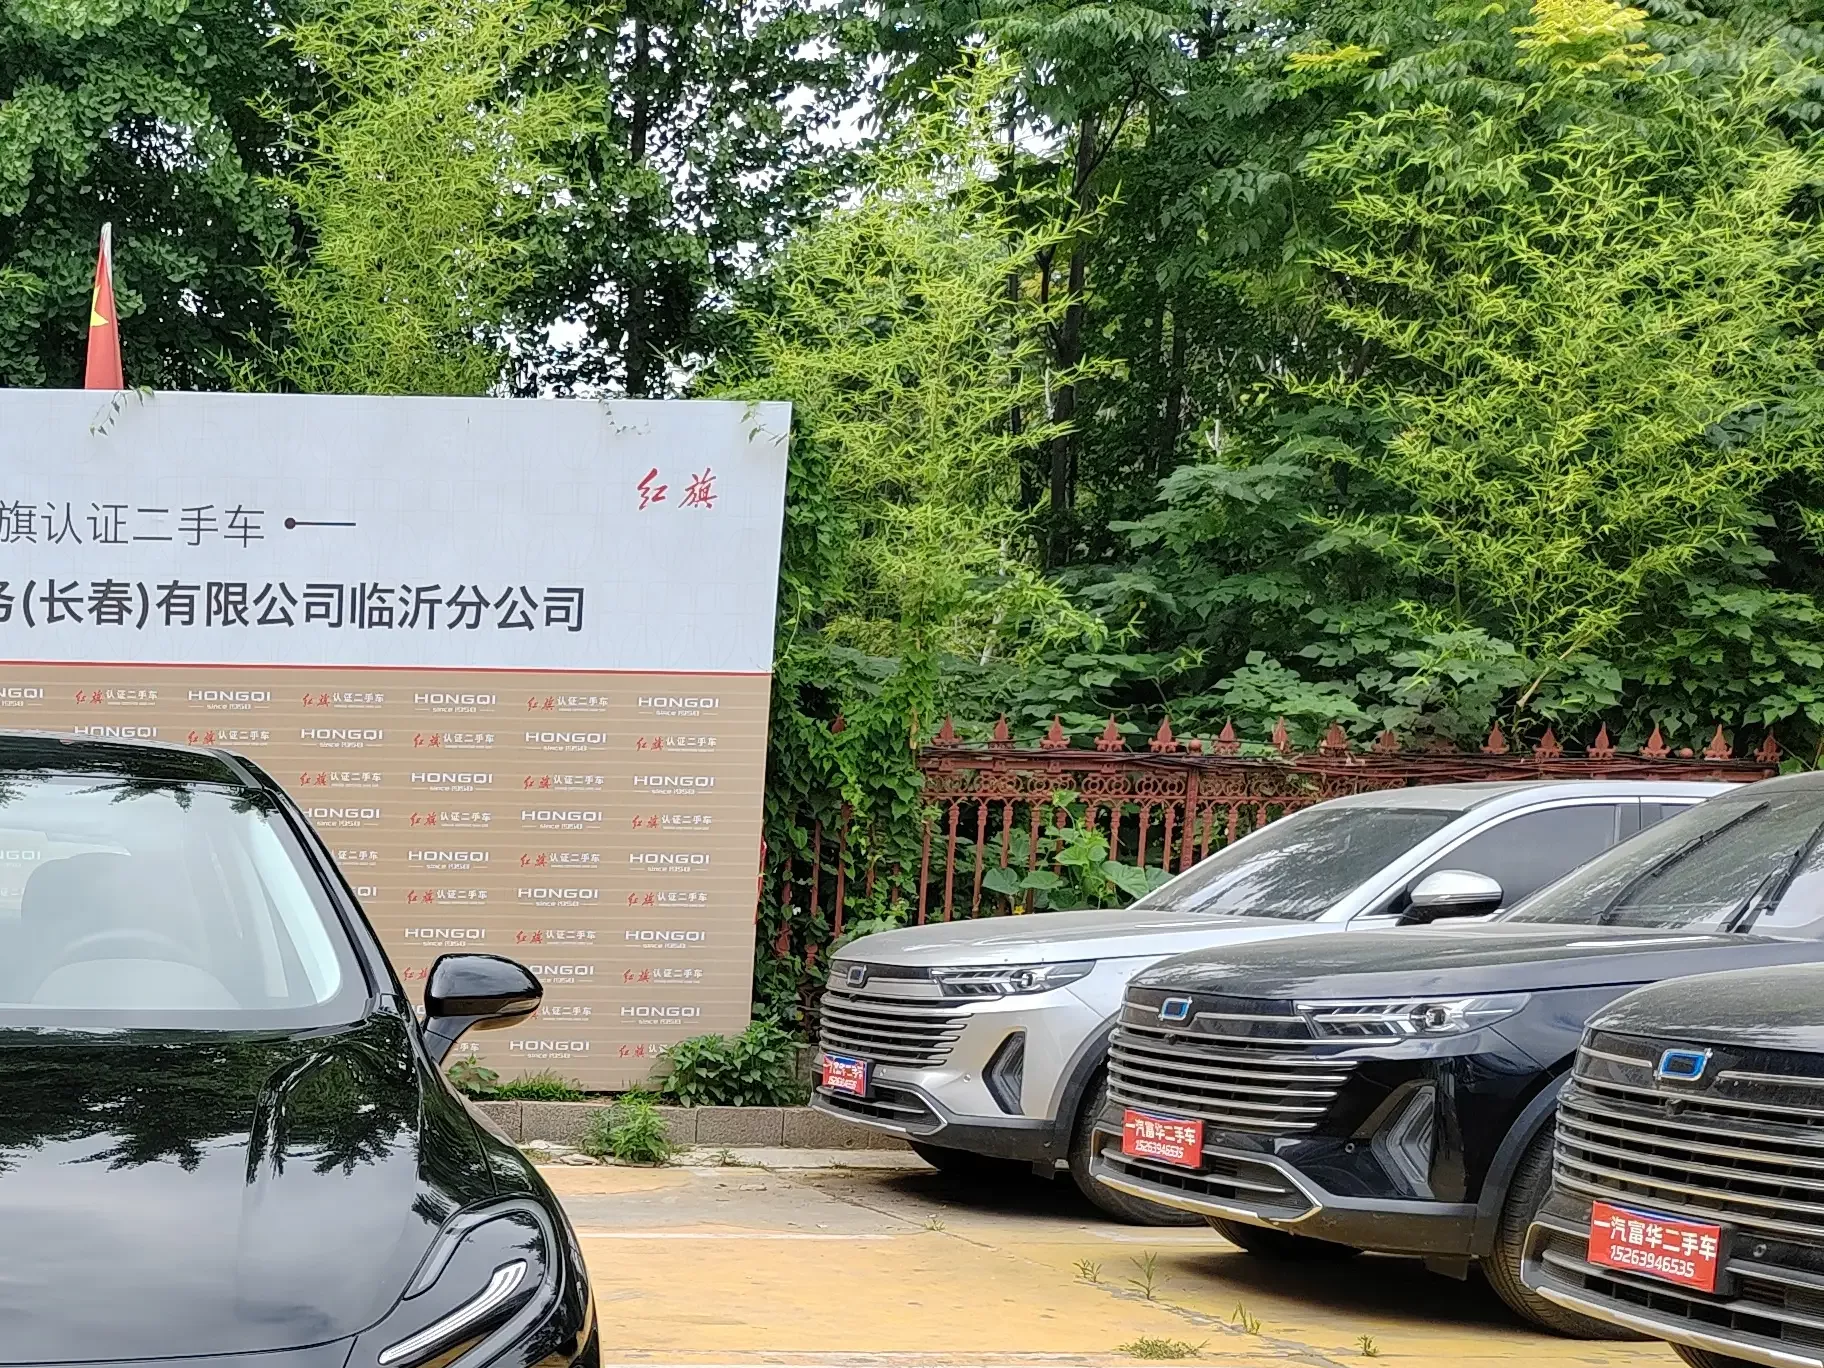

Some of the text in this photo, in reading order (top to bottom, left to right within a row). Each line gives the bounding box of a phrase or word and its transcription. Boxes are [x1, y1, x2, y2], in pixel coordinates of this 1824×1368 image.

[636, 467, 717, 511] 红旗
[106, 690, 157, 699] 认证二手车
[189, 691, 270, 701] HONGQI
[333, 693, 383, 702] 认证二手车
[415, 694, 495, 704] HONGQI
[558, 697, 608, 706] 认证二手车
[639, 697, 718, 708] HONGQI
[74, 726, 156, 737] HONGQI
[219, 731, 269, 740] 认证二手车
[301, 729, 382, 740] HONGQI
[444, 734, 494, 743] 认证二手车
[526, 732, 606, 743] HONGQI
[666, 737, 716, 746] 认证二手车
[331, 772, 381, 781] 认证二手车
[412, 773, 492, 783] HONGQI
[554, 775, 604, 784] 认证二手车
[634, 776, 714, 786] HONGQI
[305, 808, 379, 819] HONGQI
[441, 812, 490, 821] 认证二手车
[522, 811, 602, 821] HONGQI
[662, 815, 711, 824] 认证二手车
[338, 850, 378, 861] 证二手车
[409, 851, 488, 861] HONGQI
[550, 853, 599, 862] 认证二手车
[630, 854, 709, 864] HONGQI
[437, 890, 487, 899] 认证二手车
[518, 888, 598, 898] HONGQI
[658, 892, 707, 901] 认证二手车
[405, 929, 485, 939] HONGQI
[546, 930, 596, 939] 认证二手车
[626, 931, 705, 941] HONGQI
[530, 966, 594, 977] ONGQI
[653, 969, 702, 978] 认证二手车
[542, 1007, 591, 1015] 认证二手车
[621, 1007, 700, 1016] HONGQI
[510, 1041, 589, 1051] HONGQI
[1125, 1119, 1196, 1147] 一汽富华二手车
[1593, 1215, 1718, 1261] 一汽富华二手车
[1610, 1244, 1695, 1278] 15263946535
